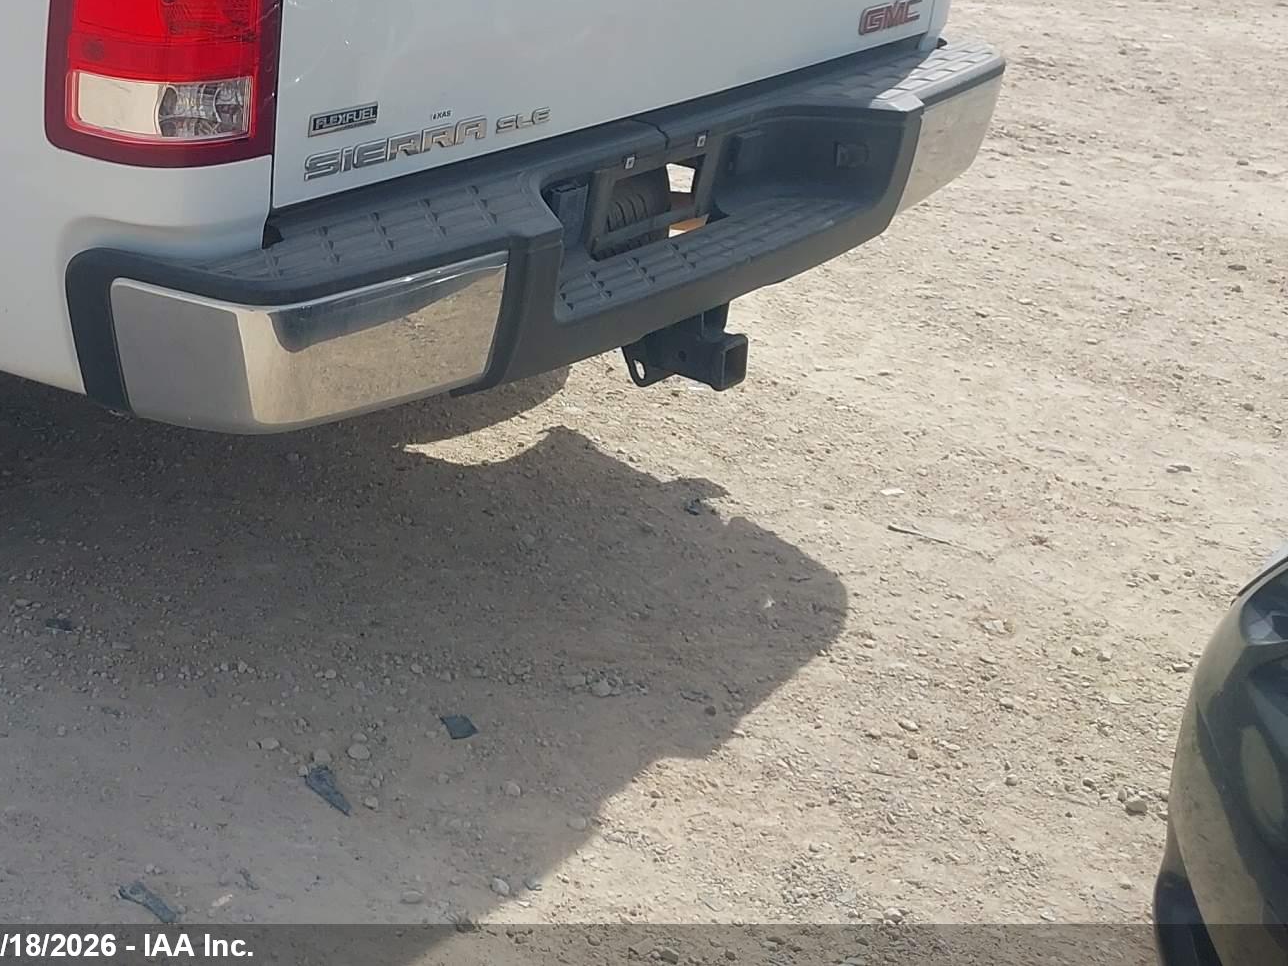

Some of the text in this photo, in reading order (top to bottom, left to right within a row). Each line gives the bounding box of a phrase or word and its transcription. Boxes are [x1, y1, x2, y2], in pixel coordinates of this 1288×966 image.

[304, 106, 551, 182] SIERRA SLE
[314, 107, 377, 131] FLEXFUEL
